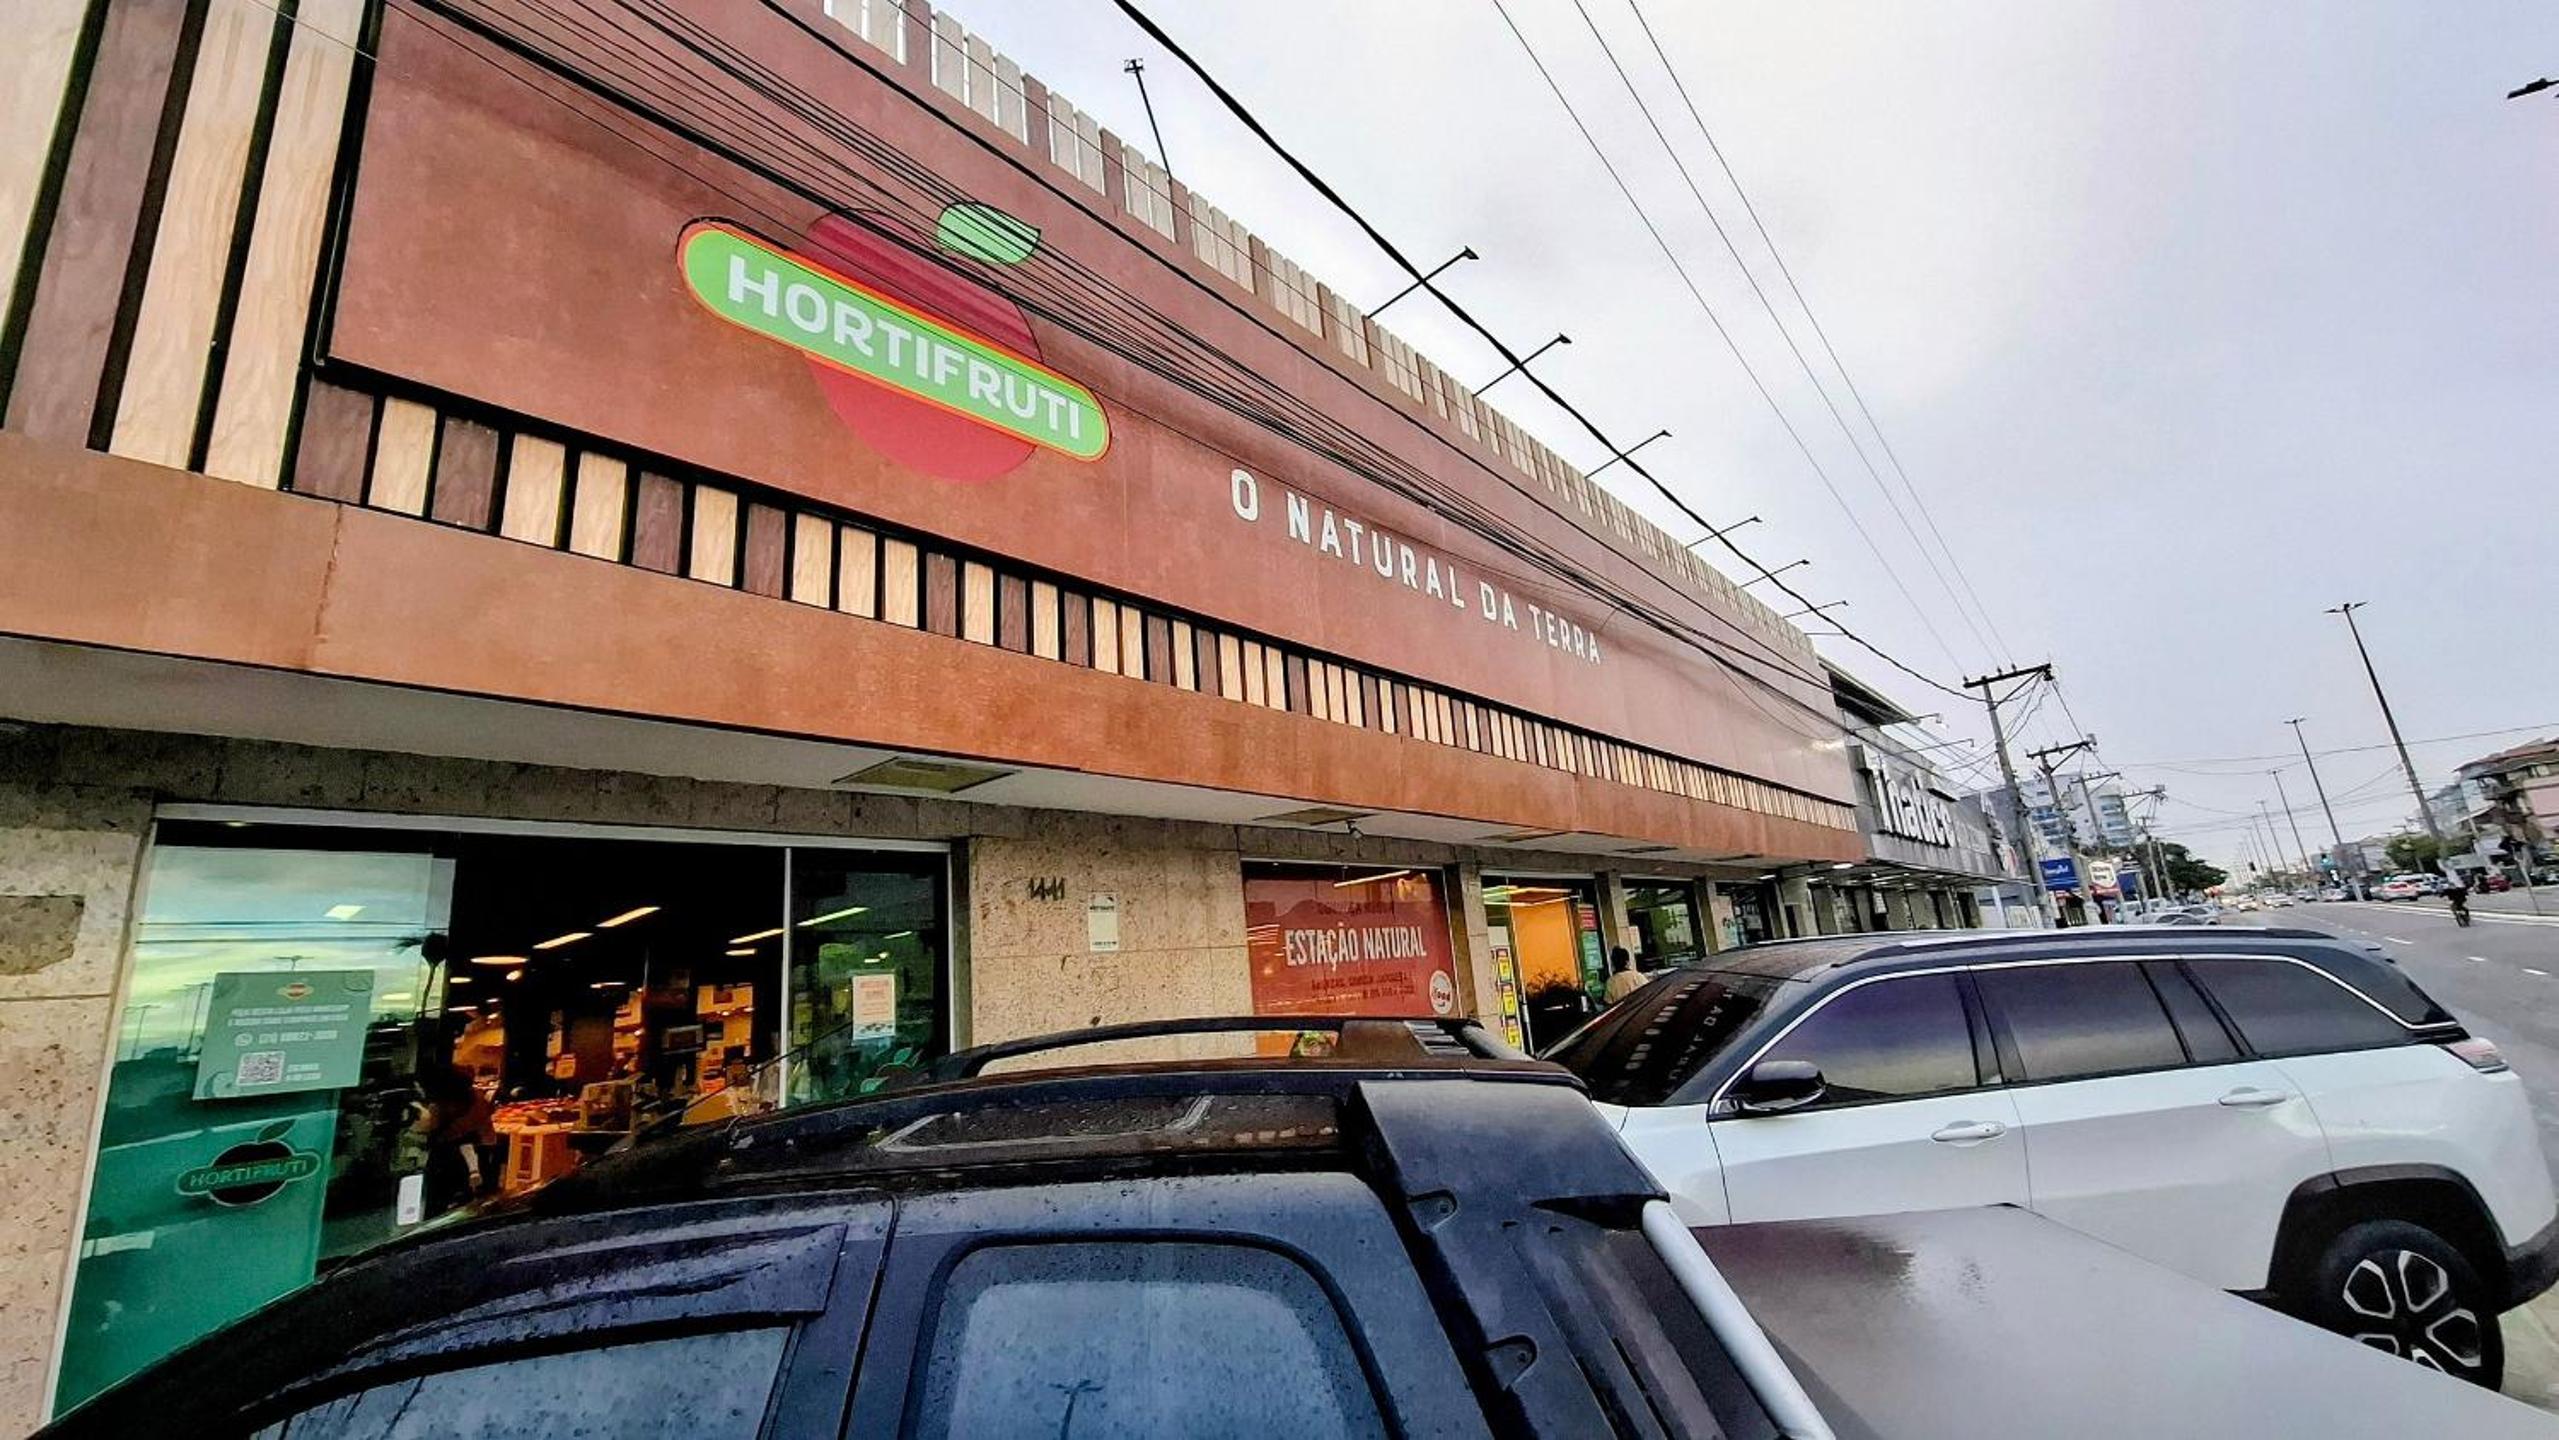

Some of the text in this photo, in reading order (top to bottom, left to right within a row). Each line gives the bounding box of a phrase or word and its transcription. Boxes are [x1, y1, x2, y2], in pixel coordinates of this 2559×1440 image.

[727, 253, 1081, 440] HORTIFRUTI
[1230, 468, 1601, 665] O NATURAL DA TERRA
[1284, 921, 1428, 972] ESTAÇÃO NATURAL
